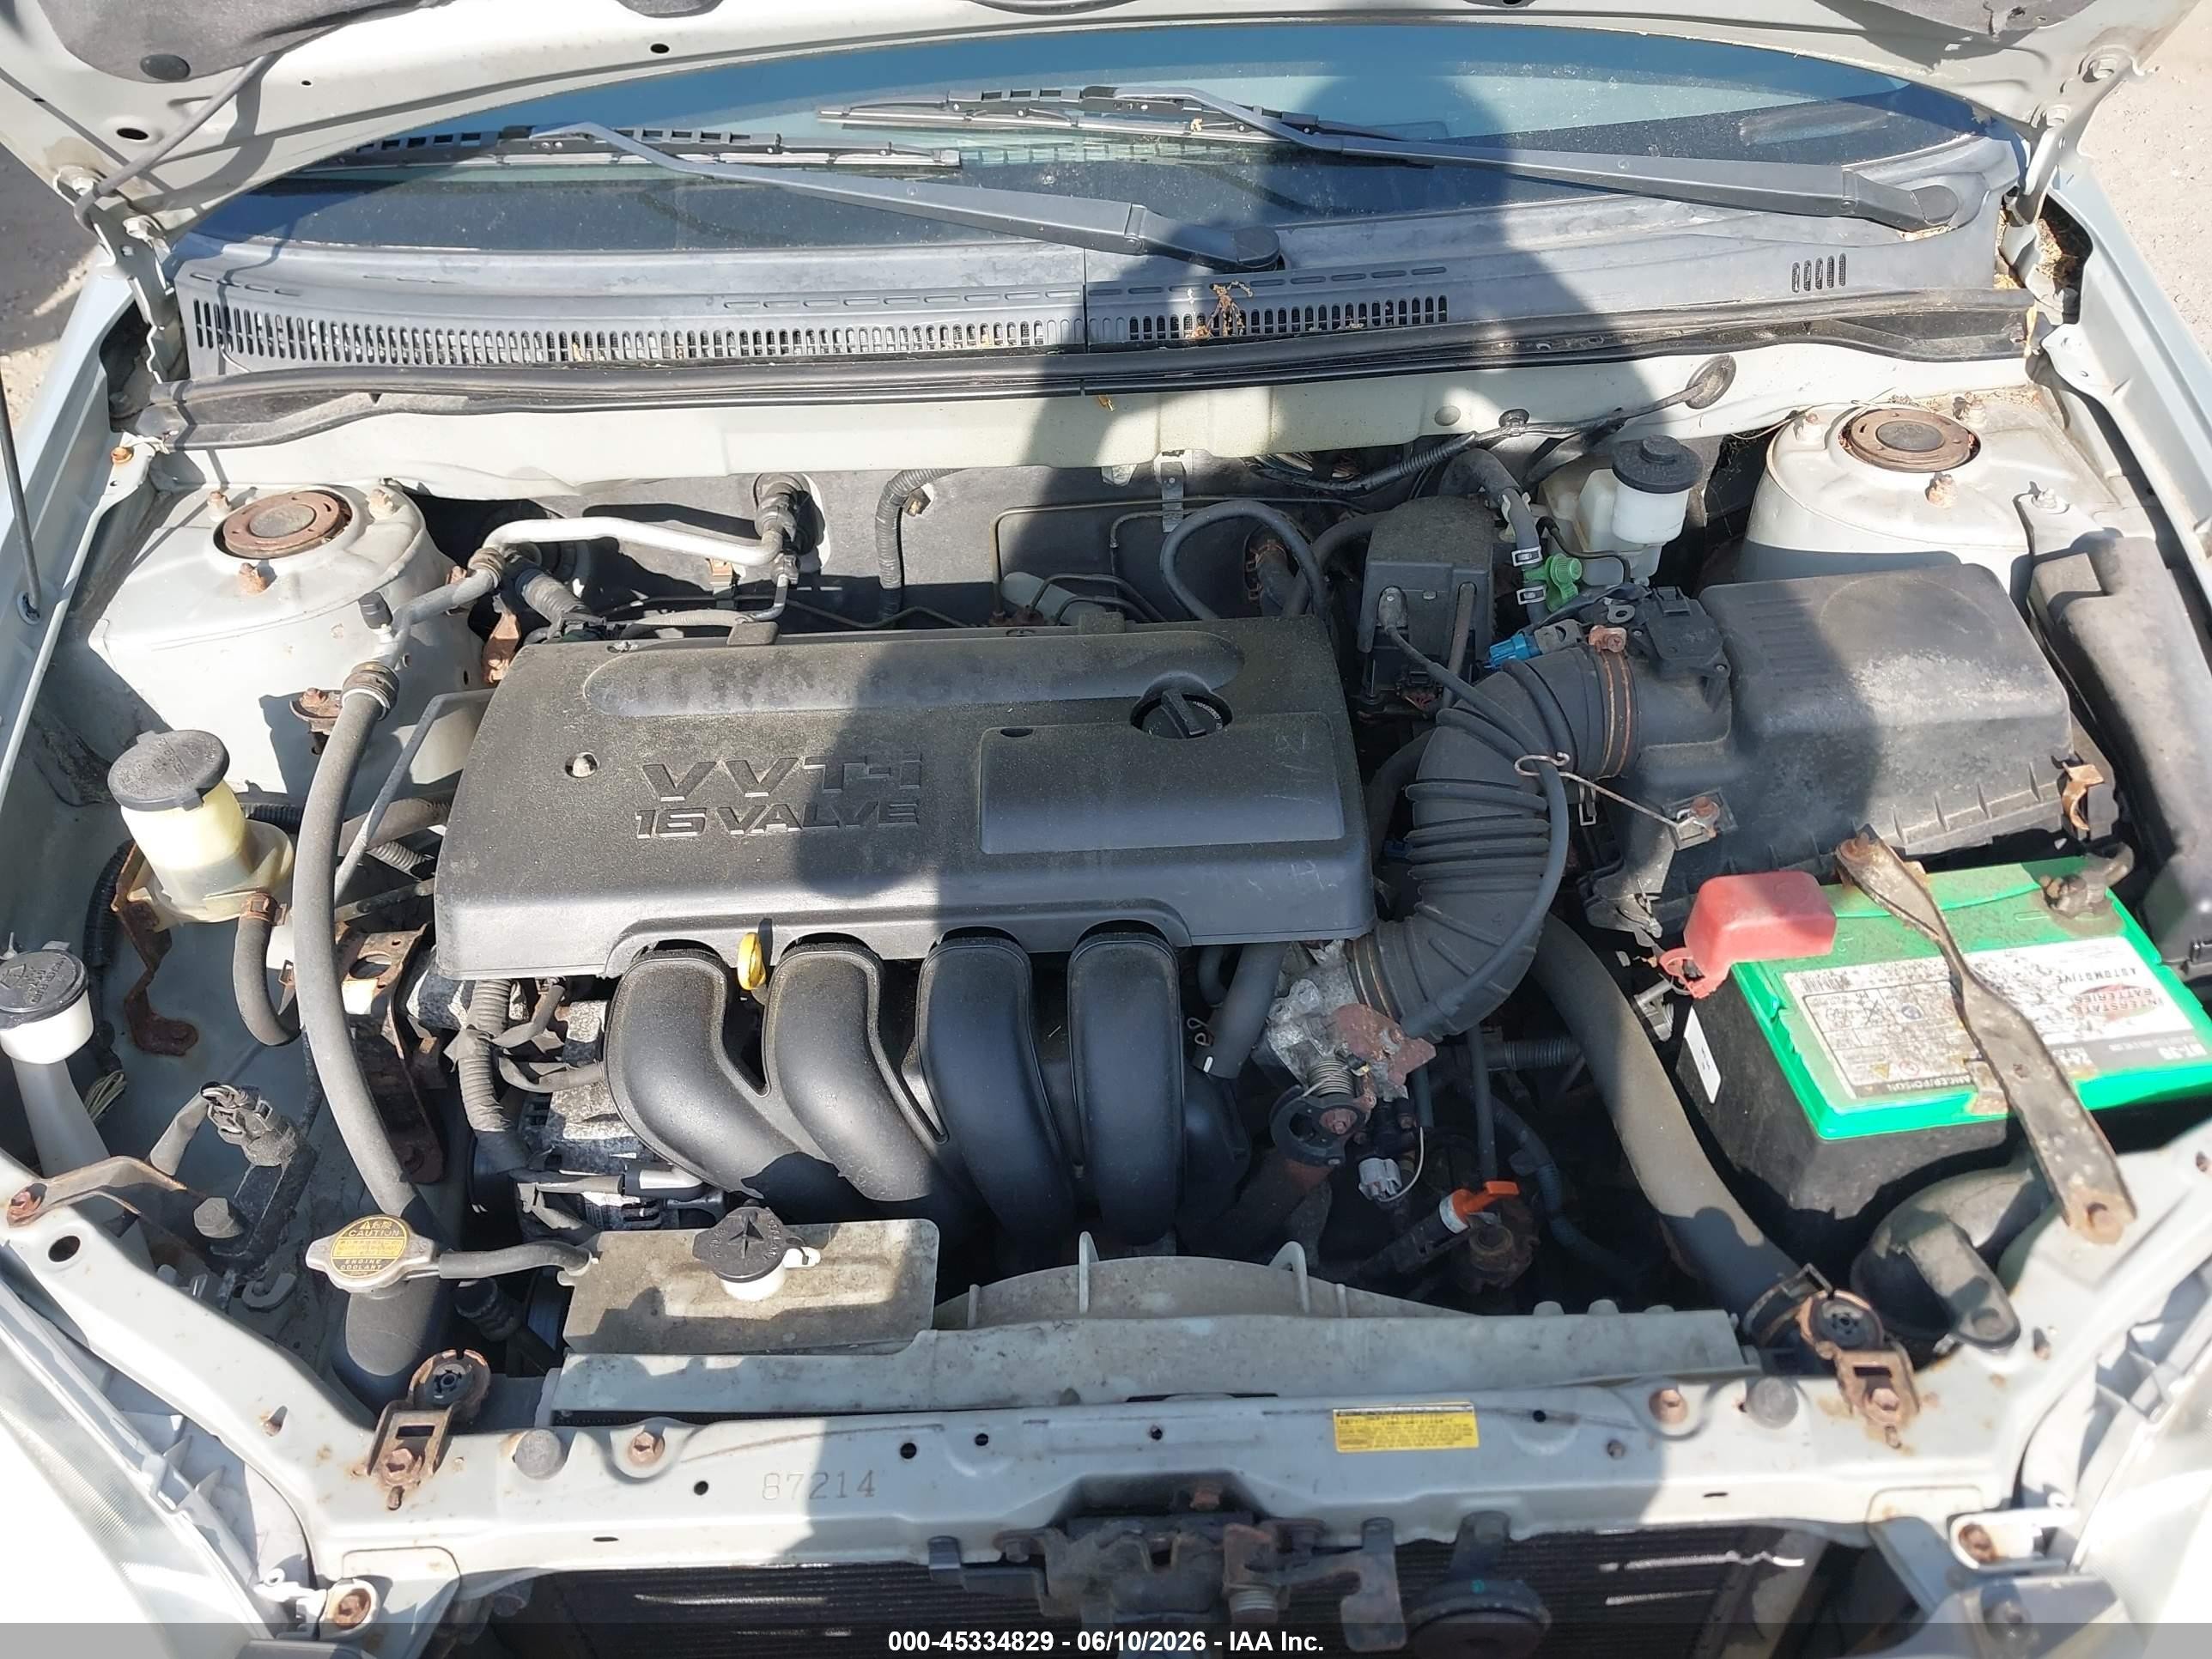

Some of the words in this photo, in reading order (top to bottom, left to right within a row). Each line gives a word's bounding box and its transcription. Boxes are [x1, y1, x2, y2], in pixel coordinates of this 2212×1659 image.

[714, 799, 923, 836] VALVE
[2057, 967, 2137, 984] AUTOMOTIVE
[2072, 996, 2164, 1016] INTERSTATE
[2074, 988, 2153, 1004] BATTERIES
[1886, 1073, 1972, 1093] ANGER/POISON
[348, 1229, 400, 1237] CAUTION
[762, 1469, 877, 1501] 87214
